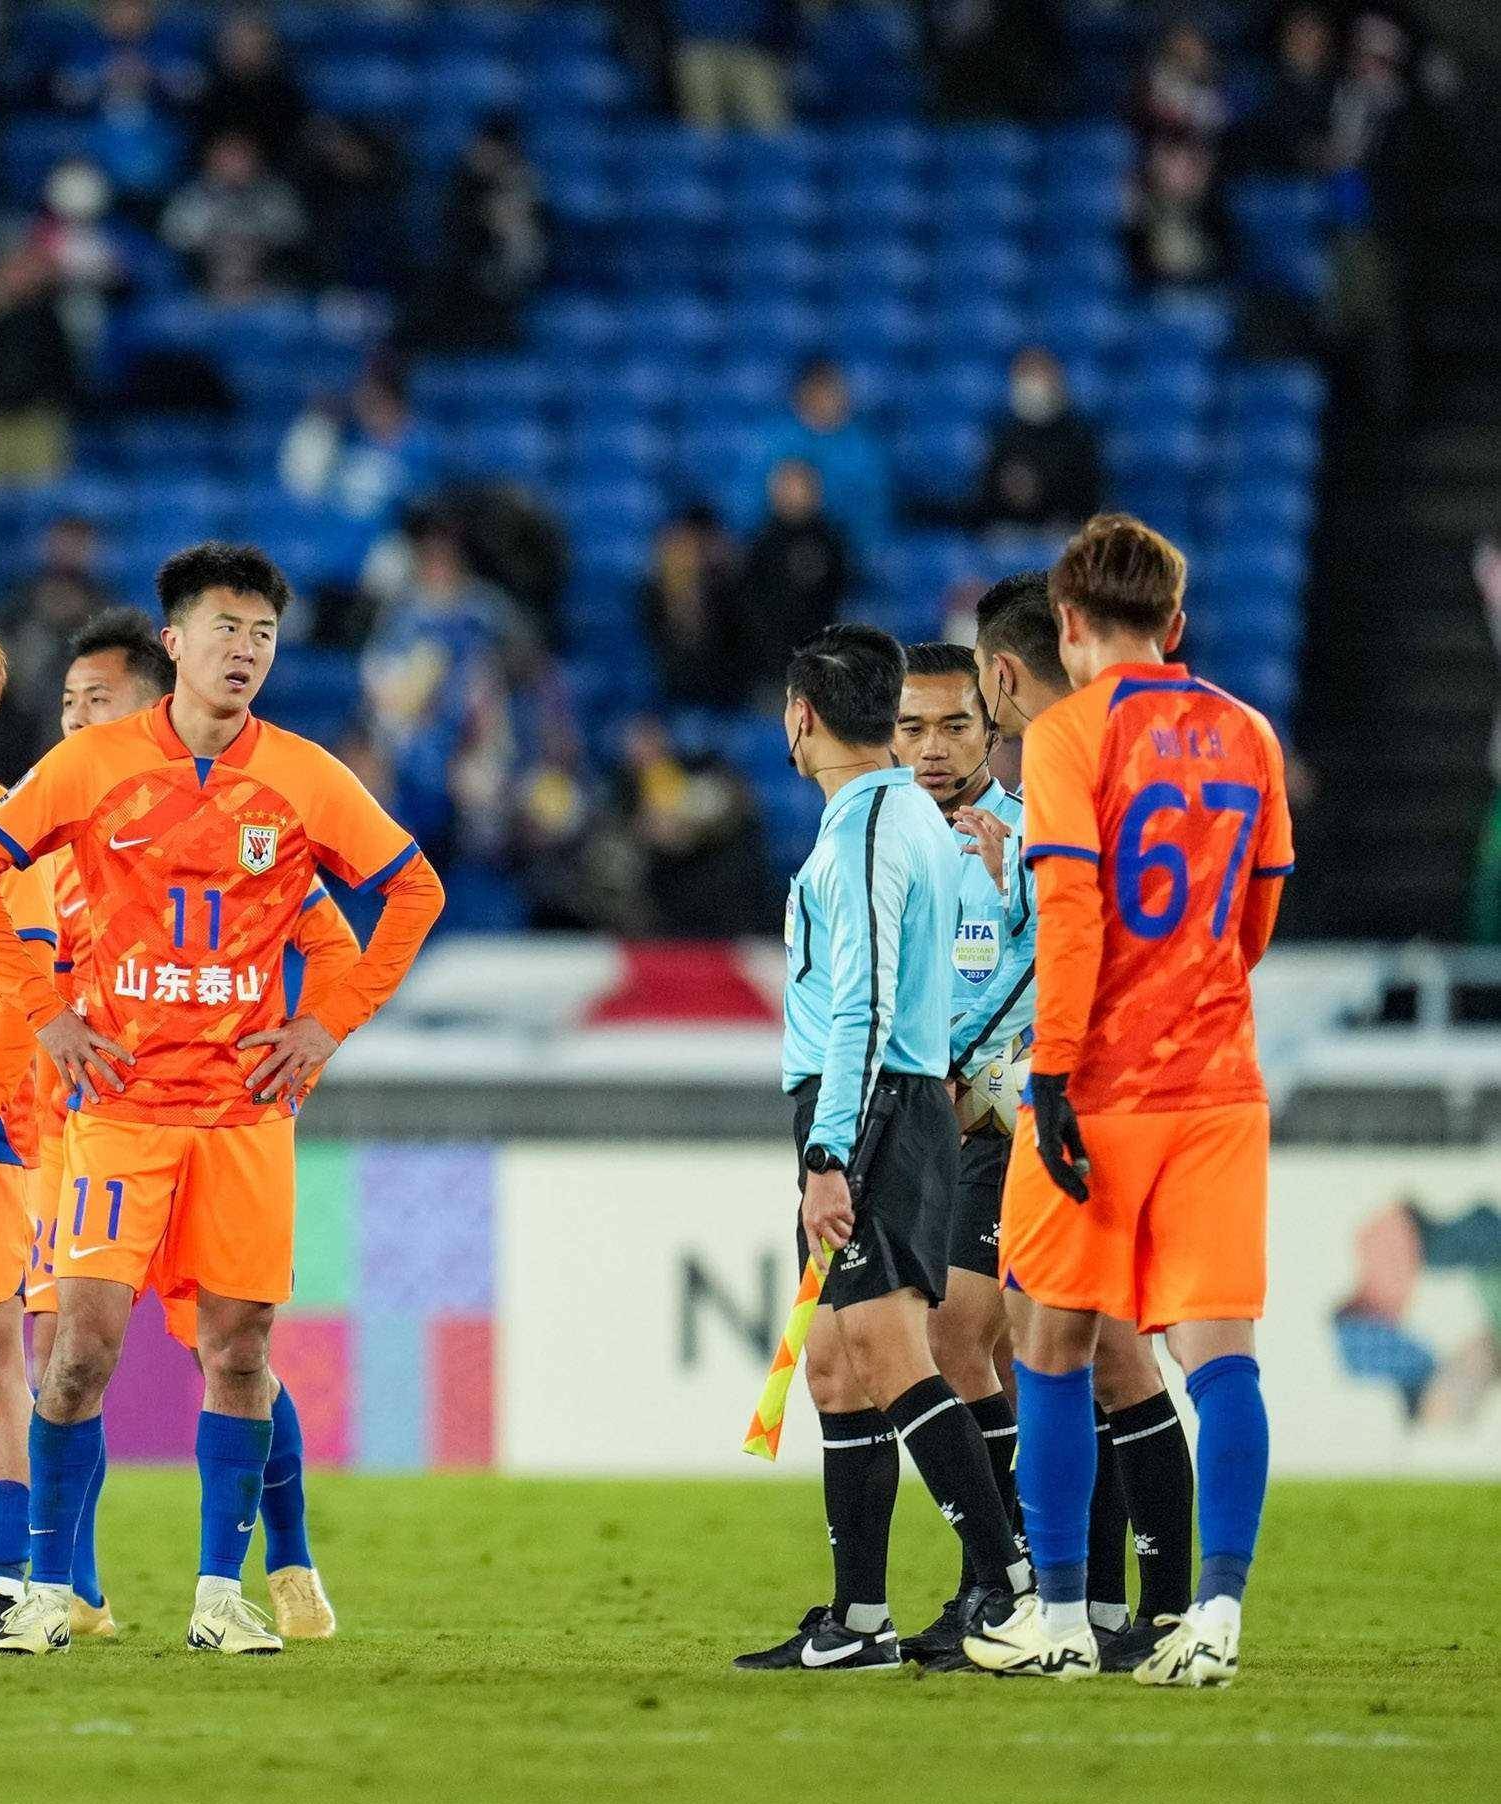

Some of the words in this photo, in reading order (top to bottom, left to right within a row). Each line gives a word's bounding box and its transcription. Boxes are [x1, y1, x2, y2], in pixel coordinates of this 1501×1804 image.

[1115, 780, 1262, 940] 67
[168, 887, 222, 950] 11
[955, 924, 995, 940] FIFA
[114, 958, 269, 1005] 山东泰山
[73, 1176, 125, 1241] 11
[840, 1256, 868, 1272] KELME
